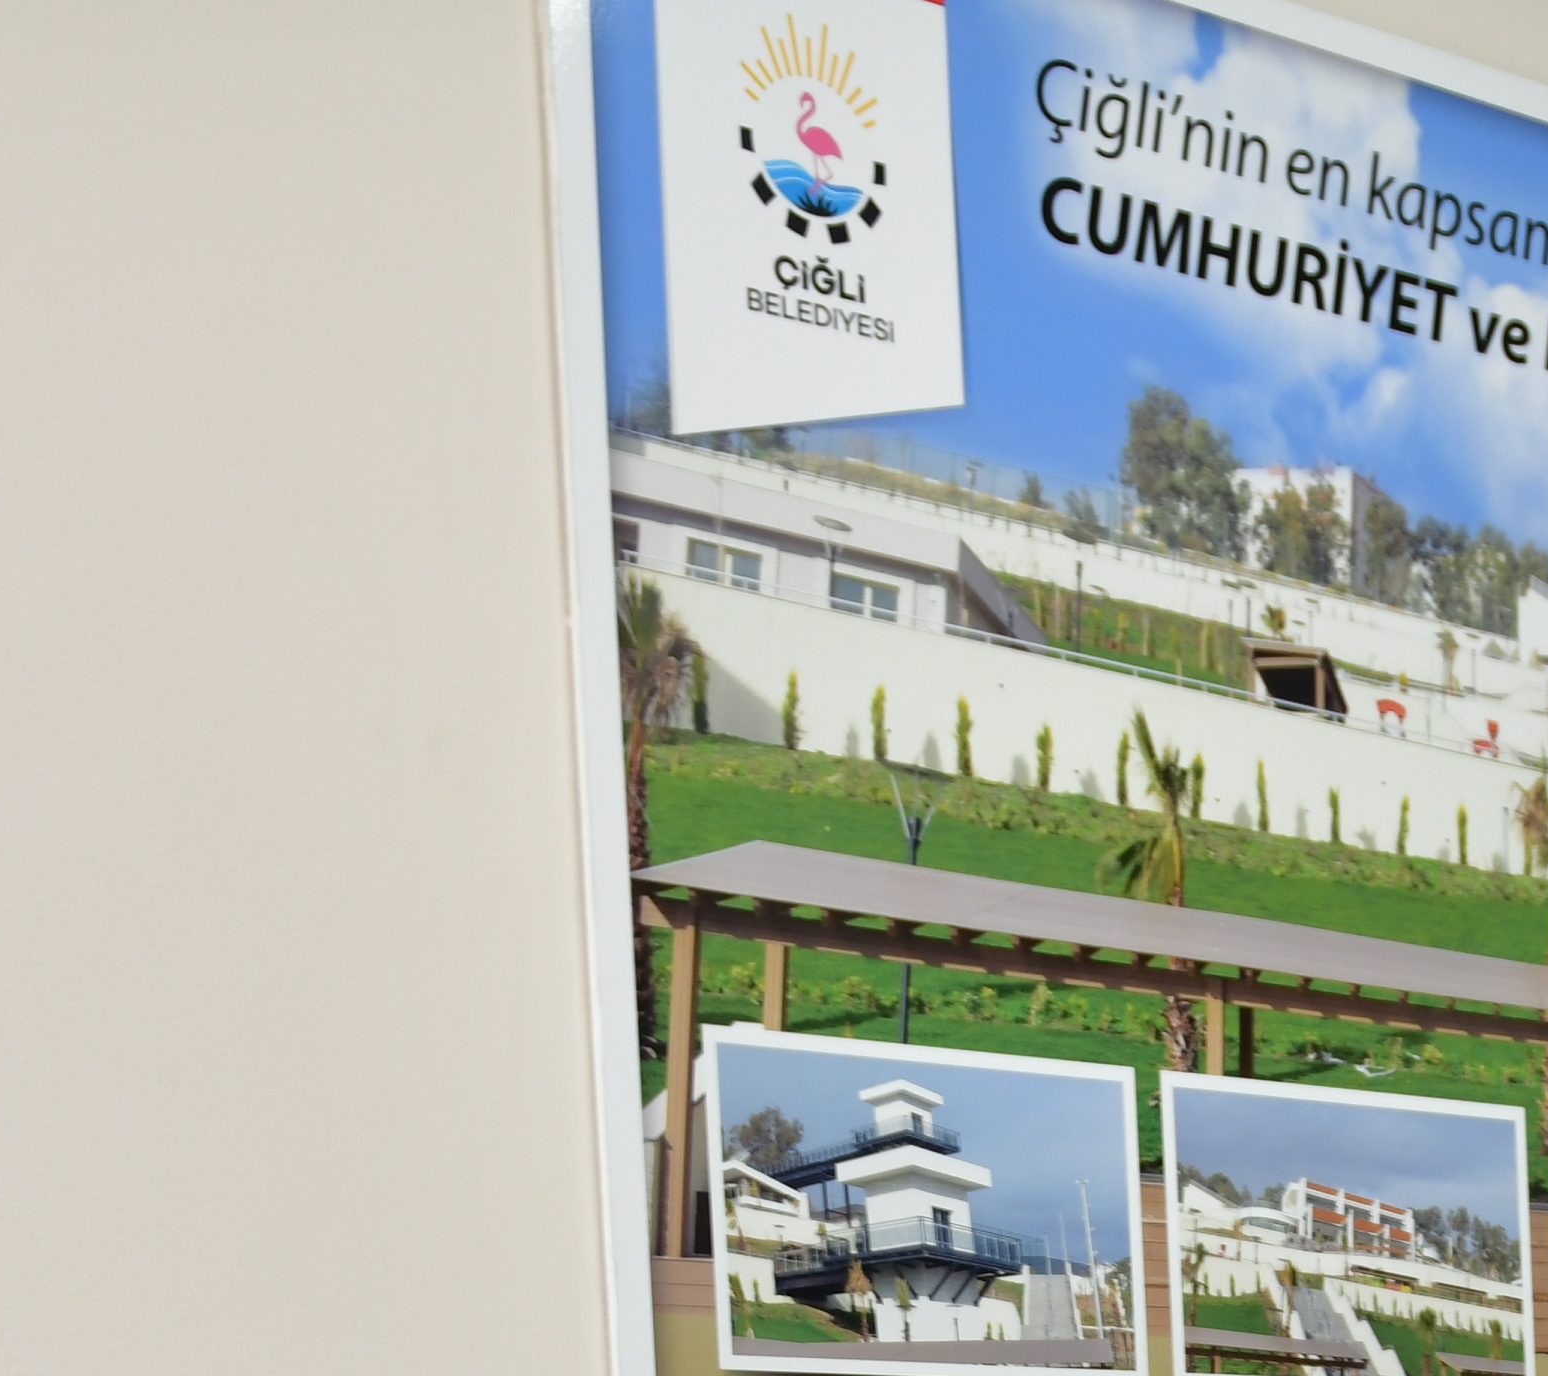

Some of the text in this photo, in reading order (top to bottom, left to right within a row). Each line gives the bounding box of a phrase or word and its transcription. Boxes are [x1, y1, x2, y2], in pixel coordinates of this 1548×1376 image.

[1287, 147, 1352, 207] en
[1039, 176, 1457, 343] CUMHURİYET
[1470, 306, 1528, 364] ve
